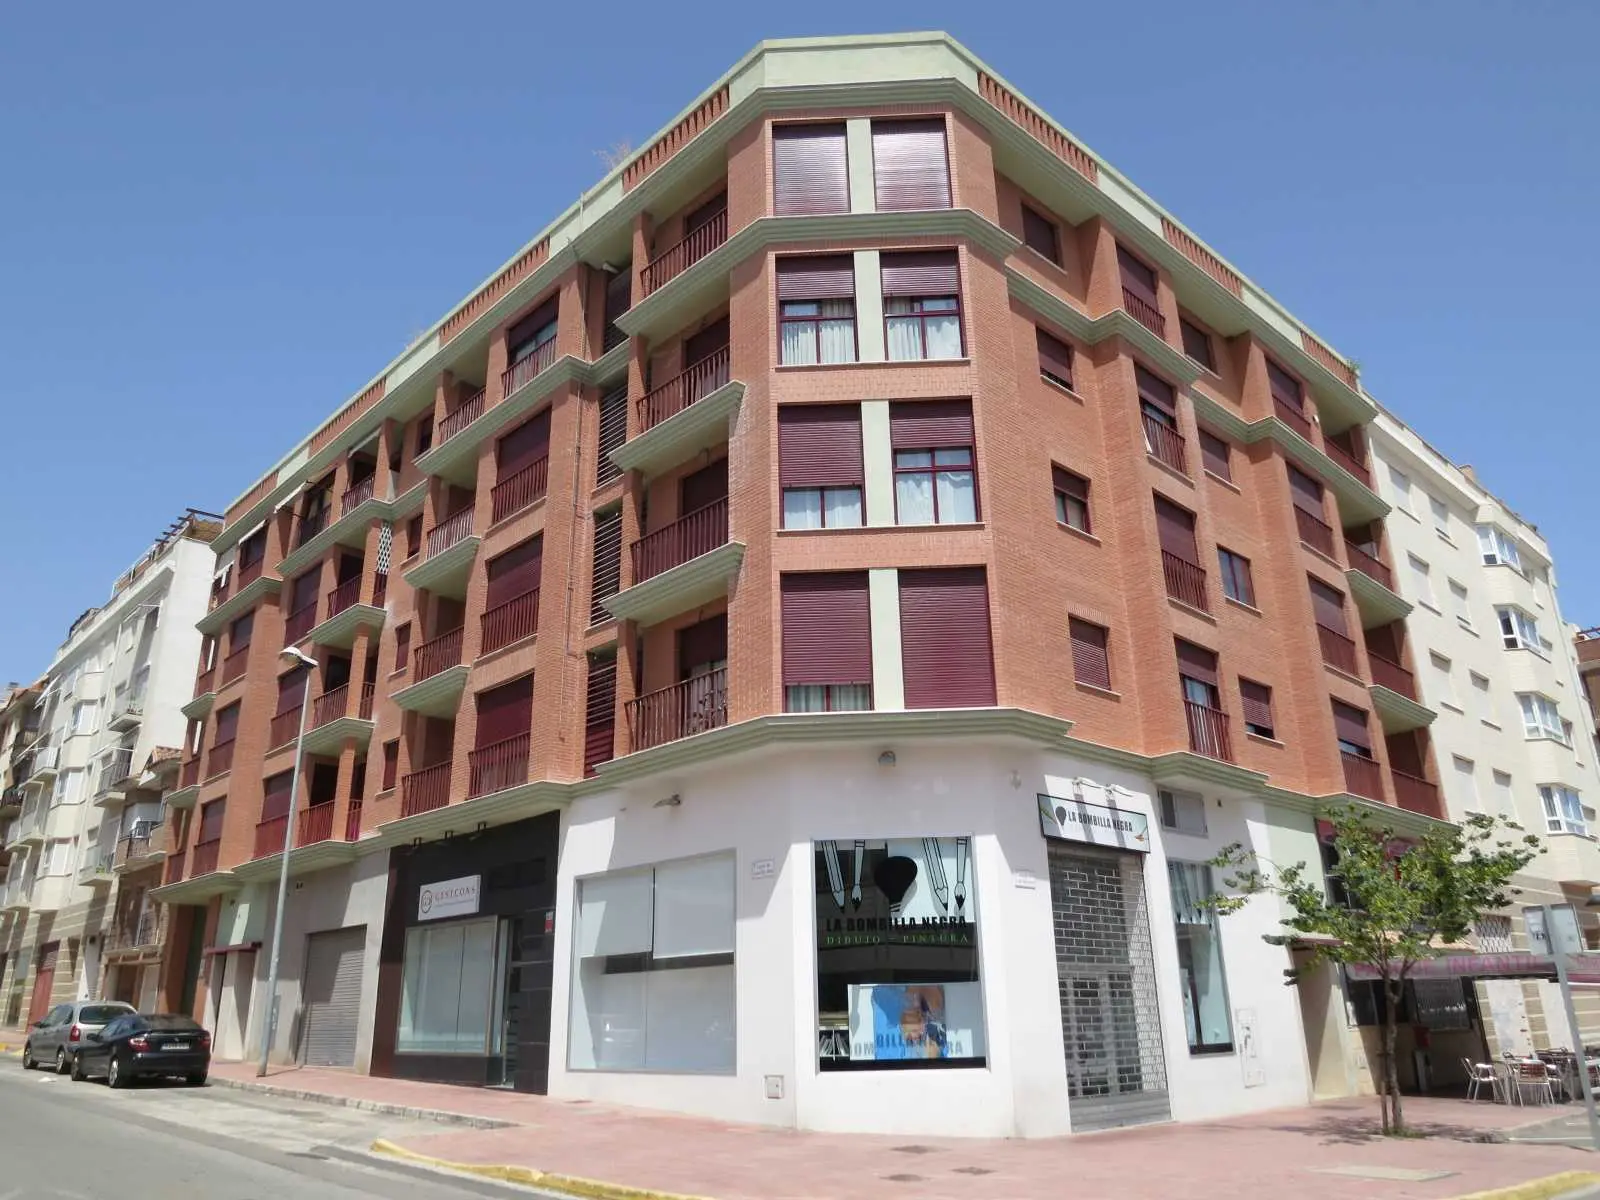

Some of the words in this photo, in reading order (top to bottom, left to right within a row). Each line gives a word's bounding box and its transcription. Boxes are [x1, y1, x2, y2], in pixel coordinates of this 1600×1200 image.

[1068, 810, 1077, 822] LA
[1078, 811, 1112, 828] BOMBILLA
[1112, 819, 1133, 832] NEGRA
[826, 918, 842, 932] LA
[846, 916, 918, 931] BOMBILLA
[921, 915, 967, 930] NEGRA
[826, 935, 881, 945] DIBUJO
[903, 934, 969, 944] PINTURA
